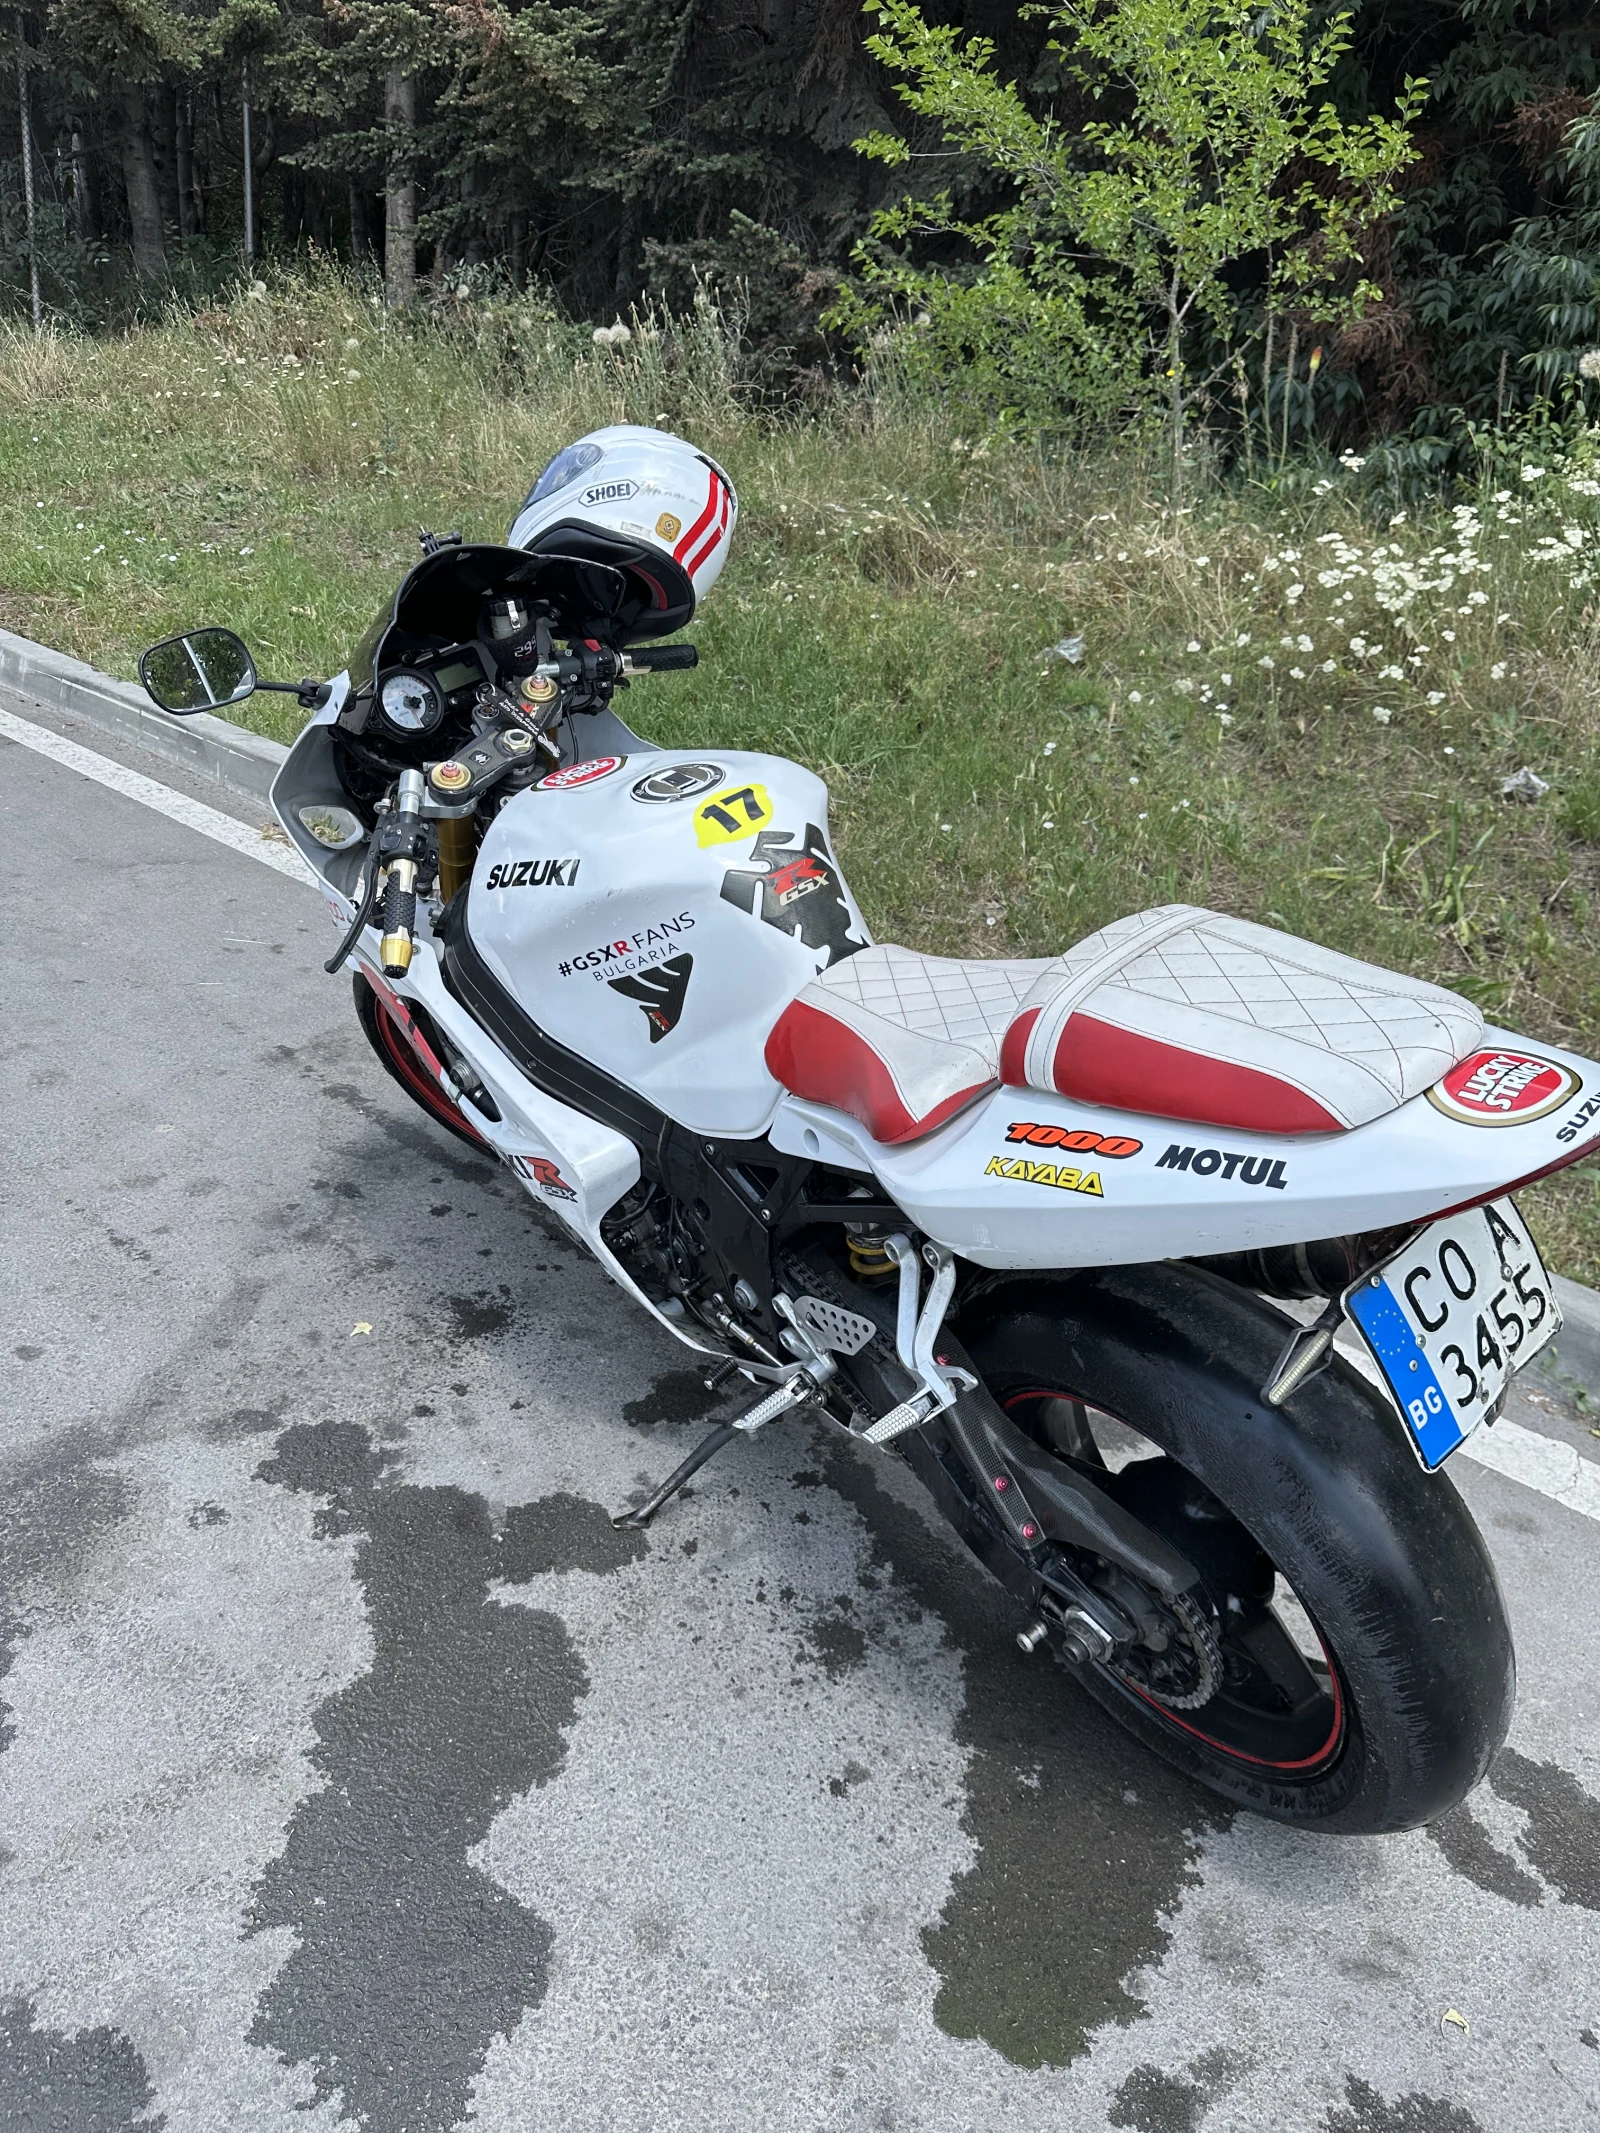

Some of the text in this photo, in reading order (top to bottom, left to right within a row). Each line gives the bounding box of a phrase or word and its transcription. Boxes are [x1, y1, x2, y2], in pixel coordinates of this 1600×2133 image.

[586, 483, 631, 503] SHOEI
[700, 787, 766, 834] 17
[486, 858, 581, 890] SUZUKI
[779, 871, 829, 906] GSX
[592, 942, 680, 982] BULGARIA
[1456, 1054, 1522, 1103] LUCKY
[1484, 1061, 1552, 1112] STRIKE
[1005, 1122, 1143, 1159] 1000
[985, 1156, 1104, 1198] KAYABA
[1154, 1144, 1289, 1190] MOTUL
[540, 1184, 575, 1201] GSX
[1403, 1238, 1477, 1333] CO
[1439, 1263, 1547, 1408] 3455
[1407, 1385, 1443, 1431] BG
